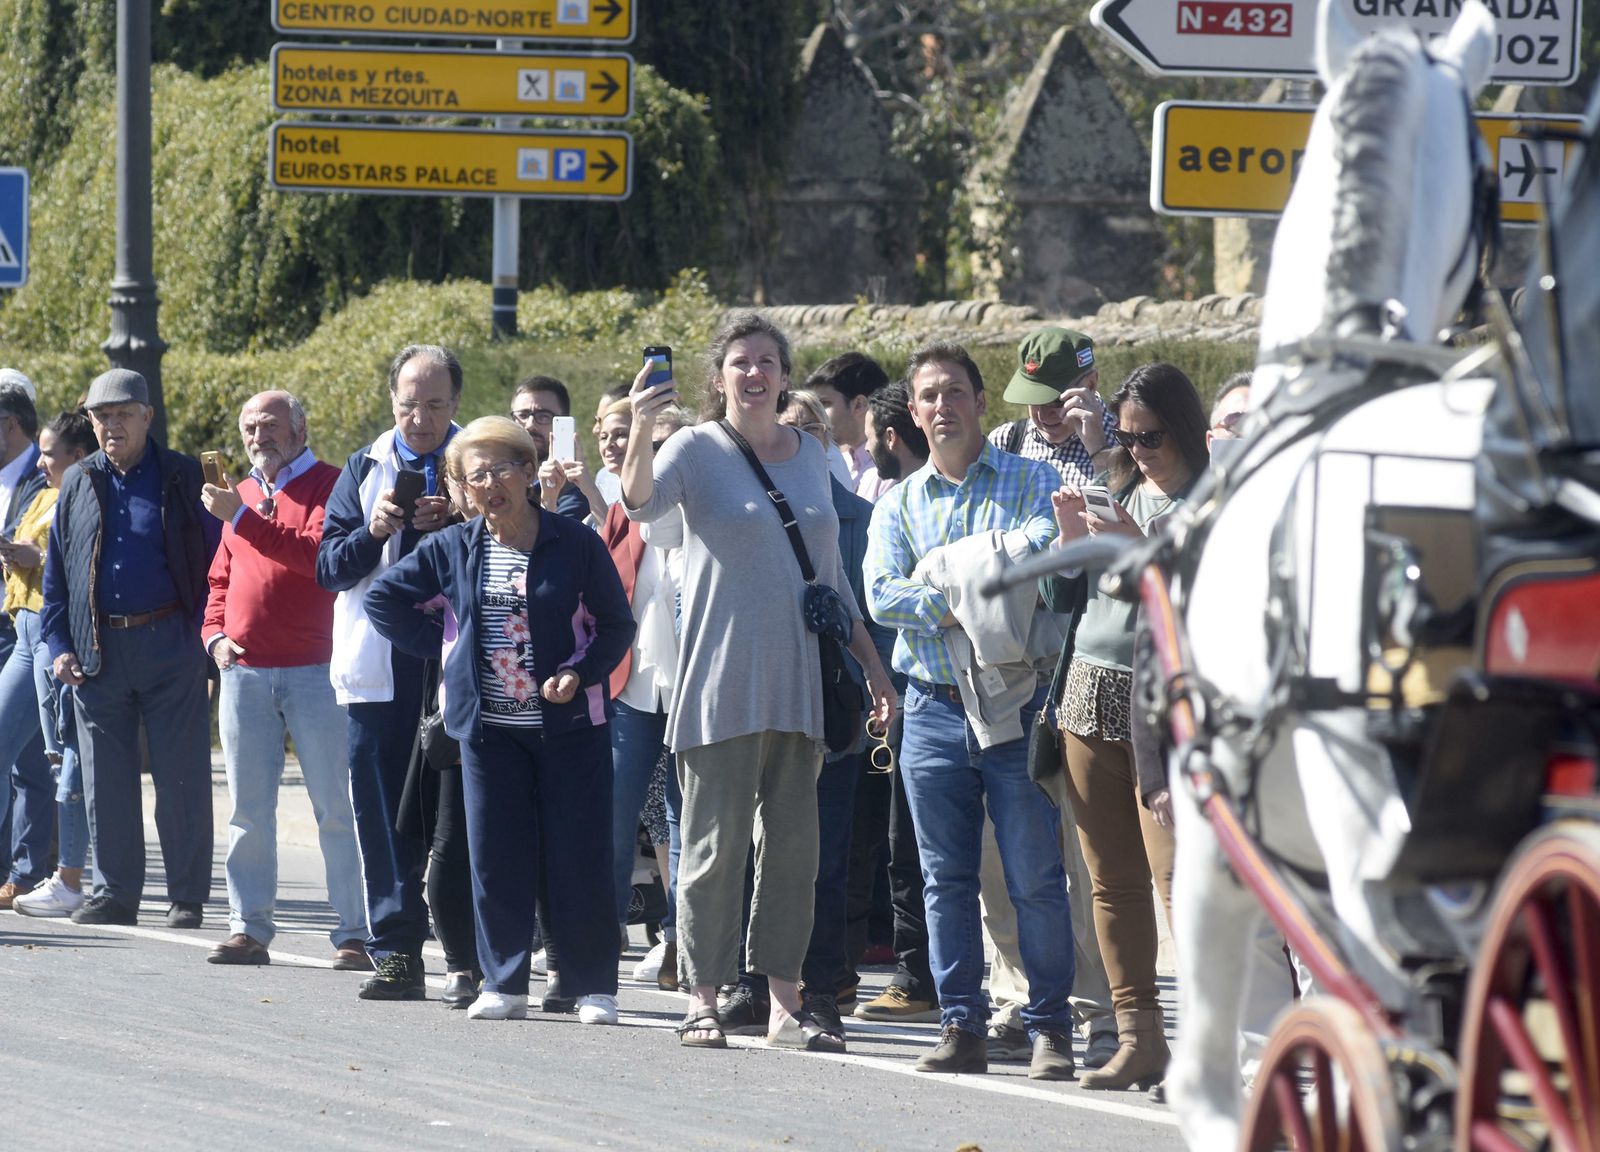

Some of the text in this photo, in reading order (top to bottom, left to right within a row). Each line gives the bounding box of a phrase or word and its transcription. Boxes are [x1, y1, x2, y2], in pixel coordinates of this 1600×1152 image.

[282, 3, 375, 23] CENTRO
[1179, 5, 1290, 33] N-432
[282, 64, 429, 84] hoteles y rtes.
[282, 85, 460, 107] ZONA MEZQUITA
[279, 135, 340, 154] hotel
[279, 161, 497, 186] EUROSTARS PALACE
[558, 151, 581, 179] P
